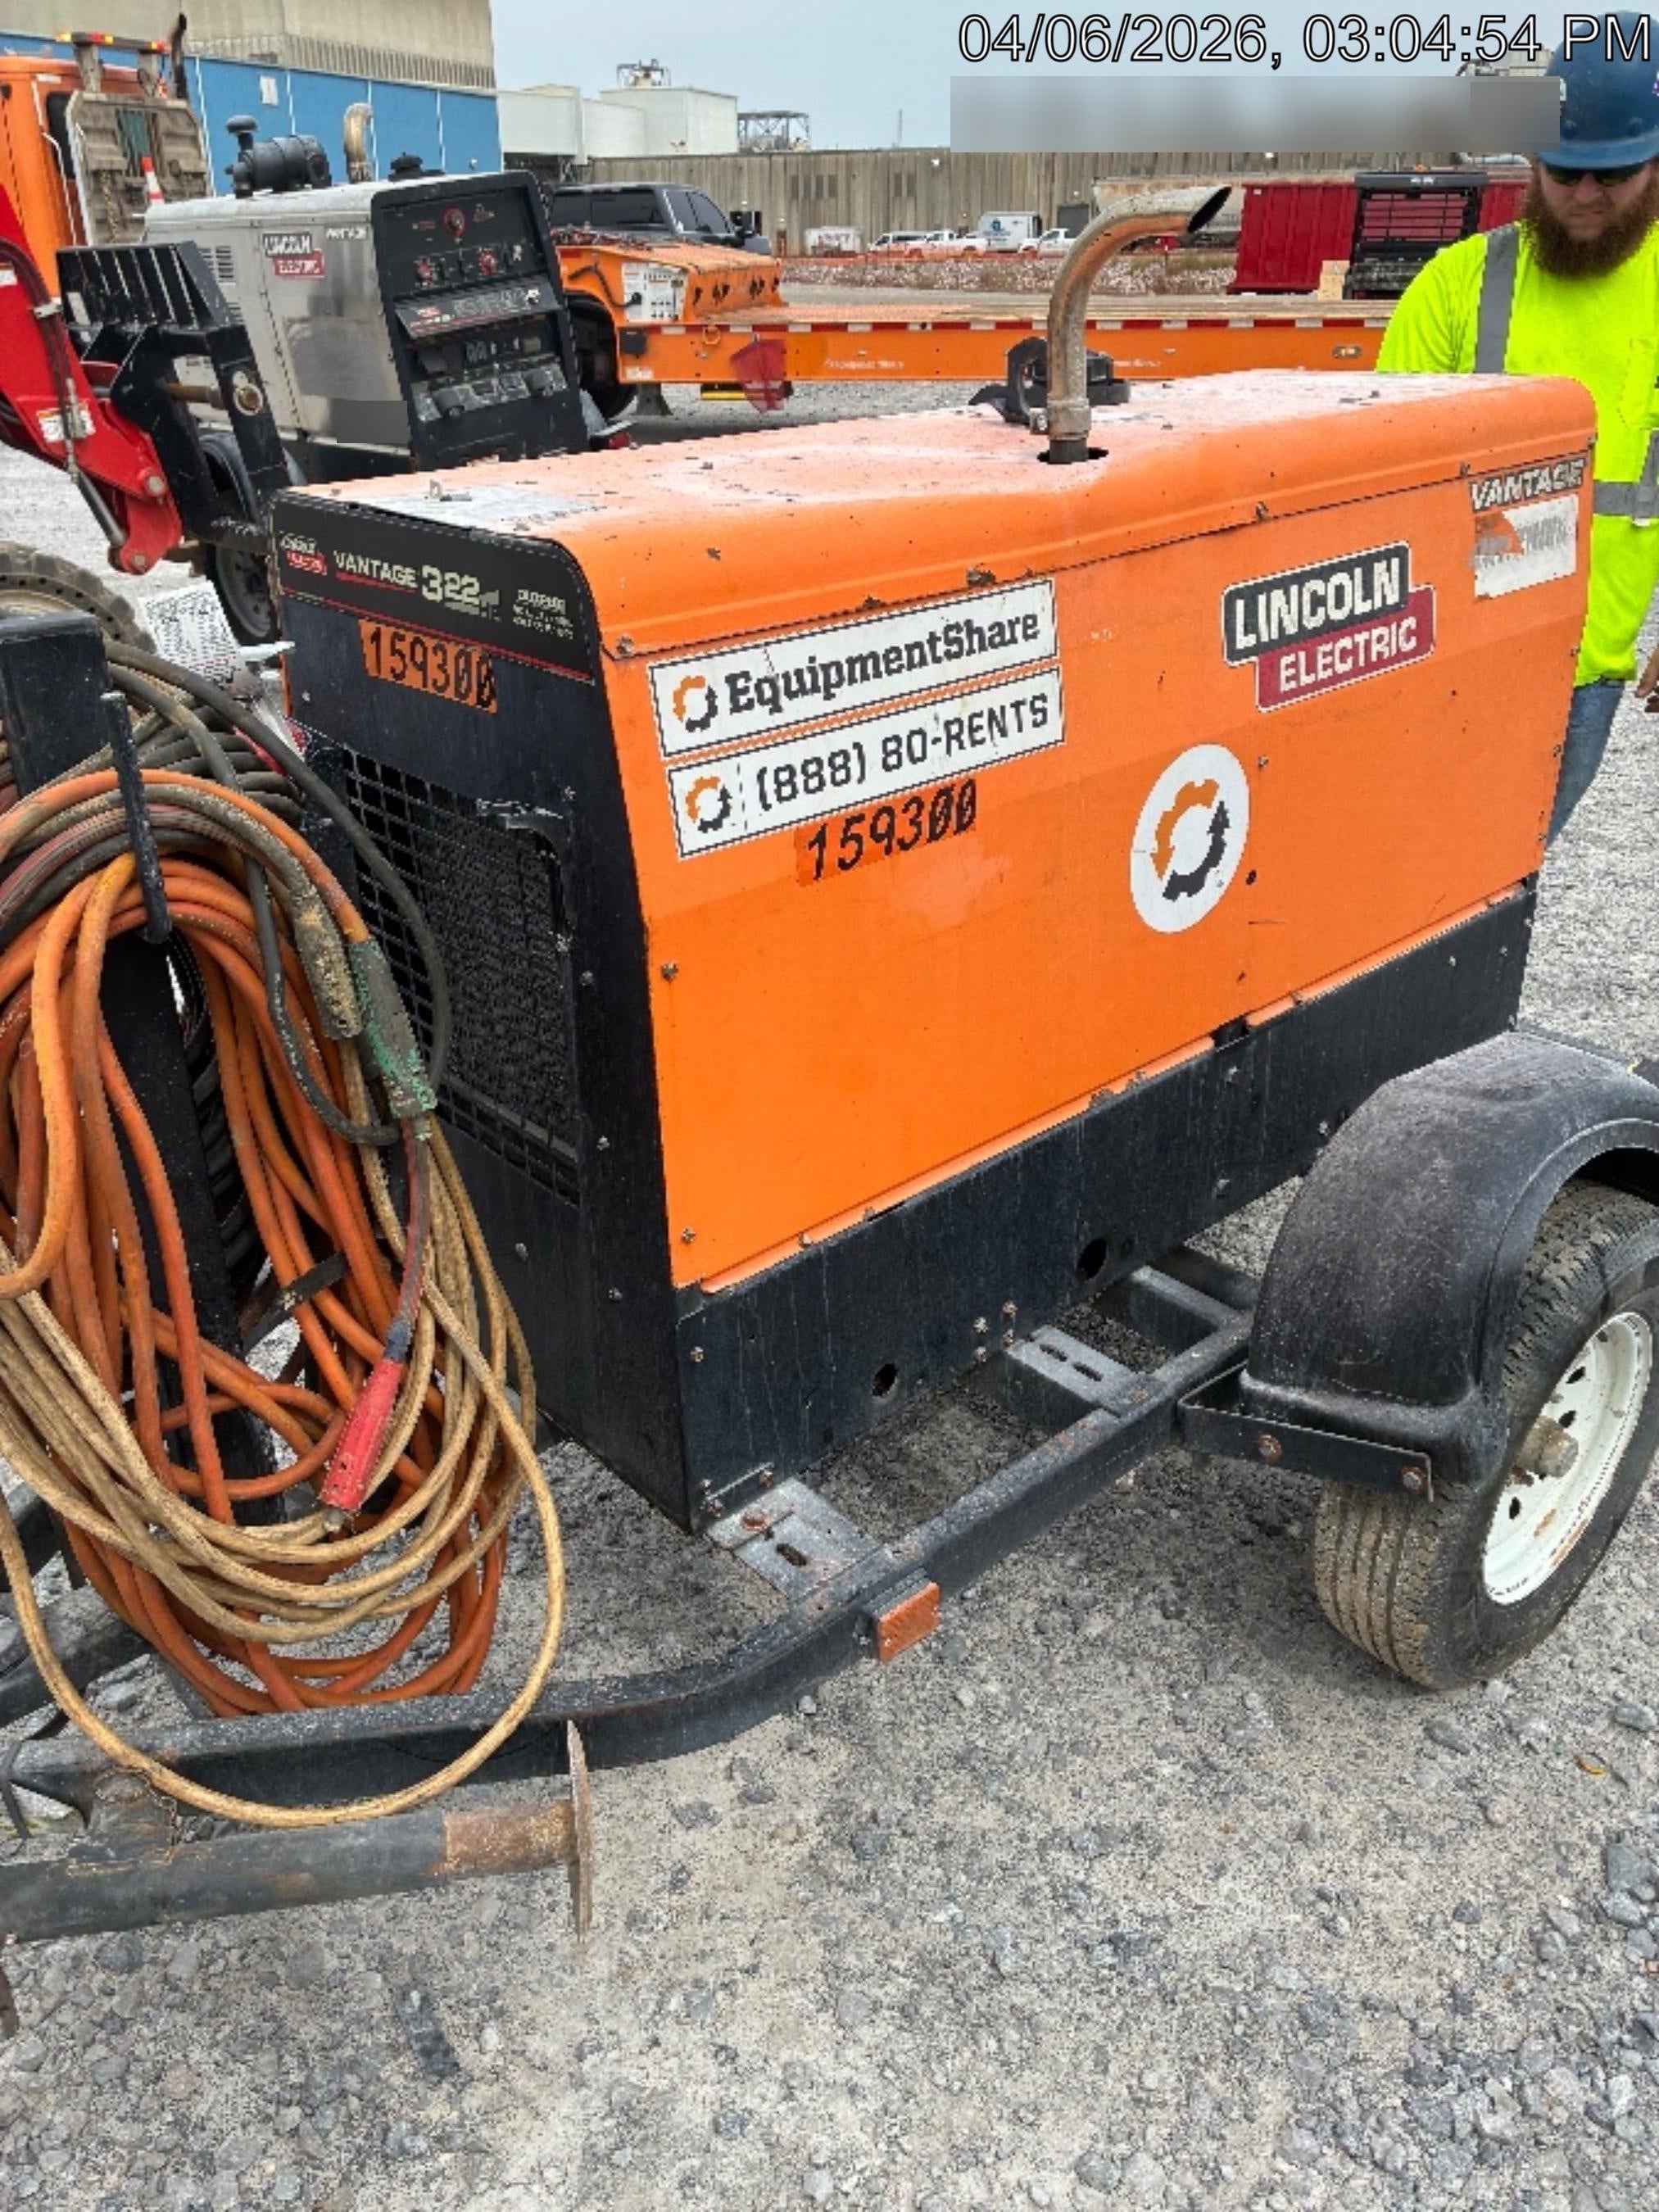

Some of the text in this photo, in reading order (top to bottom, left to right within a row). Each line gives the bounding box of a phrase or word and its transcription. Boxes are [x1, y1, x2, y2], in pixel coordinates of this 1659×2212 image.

[1471, 459, 1584, 510] VANTAGE
[333, 550, 419, 589] VANTAGE
[422, 564, 480, 605] 322
[1235, 556, 1402, 650] LINCOLN
[370, 627, 496, 708] 159300
[725, 613, 1040, 716] EquipmentShare
[1280, 617, 1418, 692] ELECTRIC
[756, 693, 1049, 812] (888) 80-RENTS
[807, 779, 978, 881] 159300
